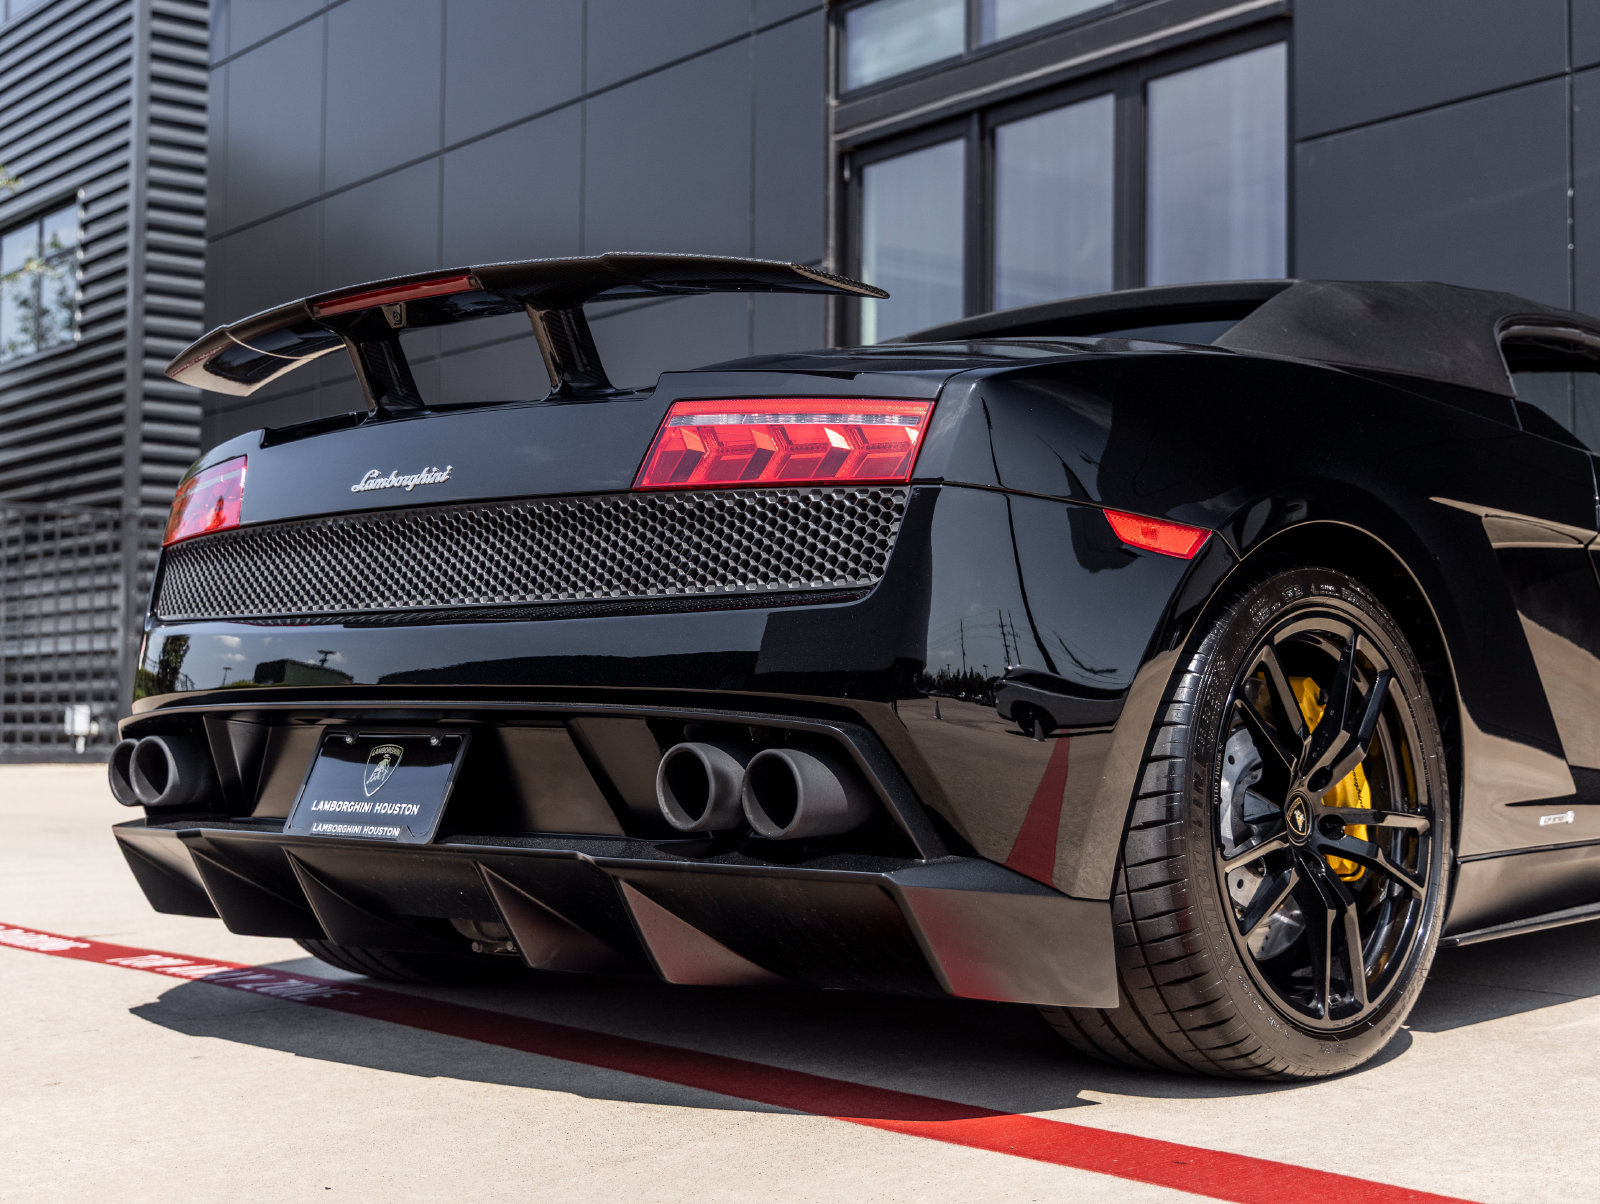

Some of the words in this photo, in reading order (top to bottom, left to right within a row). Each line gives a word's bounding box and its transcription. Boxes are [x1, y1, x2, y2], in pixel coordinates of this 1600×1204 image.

[351, 465, 453, 492] Lamborghini
[311, 800, 373, 813] LAMBORGHINI
[373, 802, 420, 815] HOUSTON
[312, 823, 362, 834] LAMBORGHINI
[362, 826, 400, 837] HOUSTON
